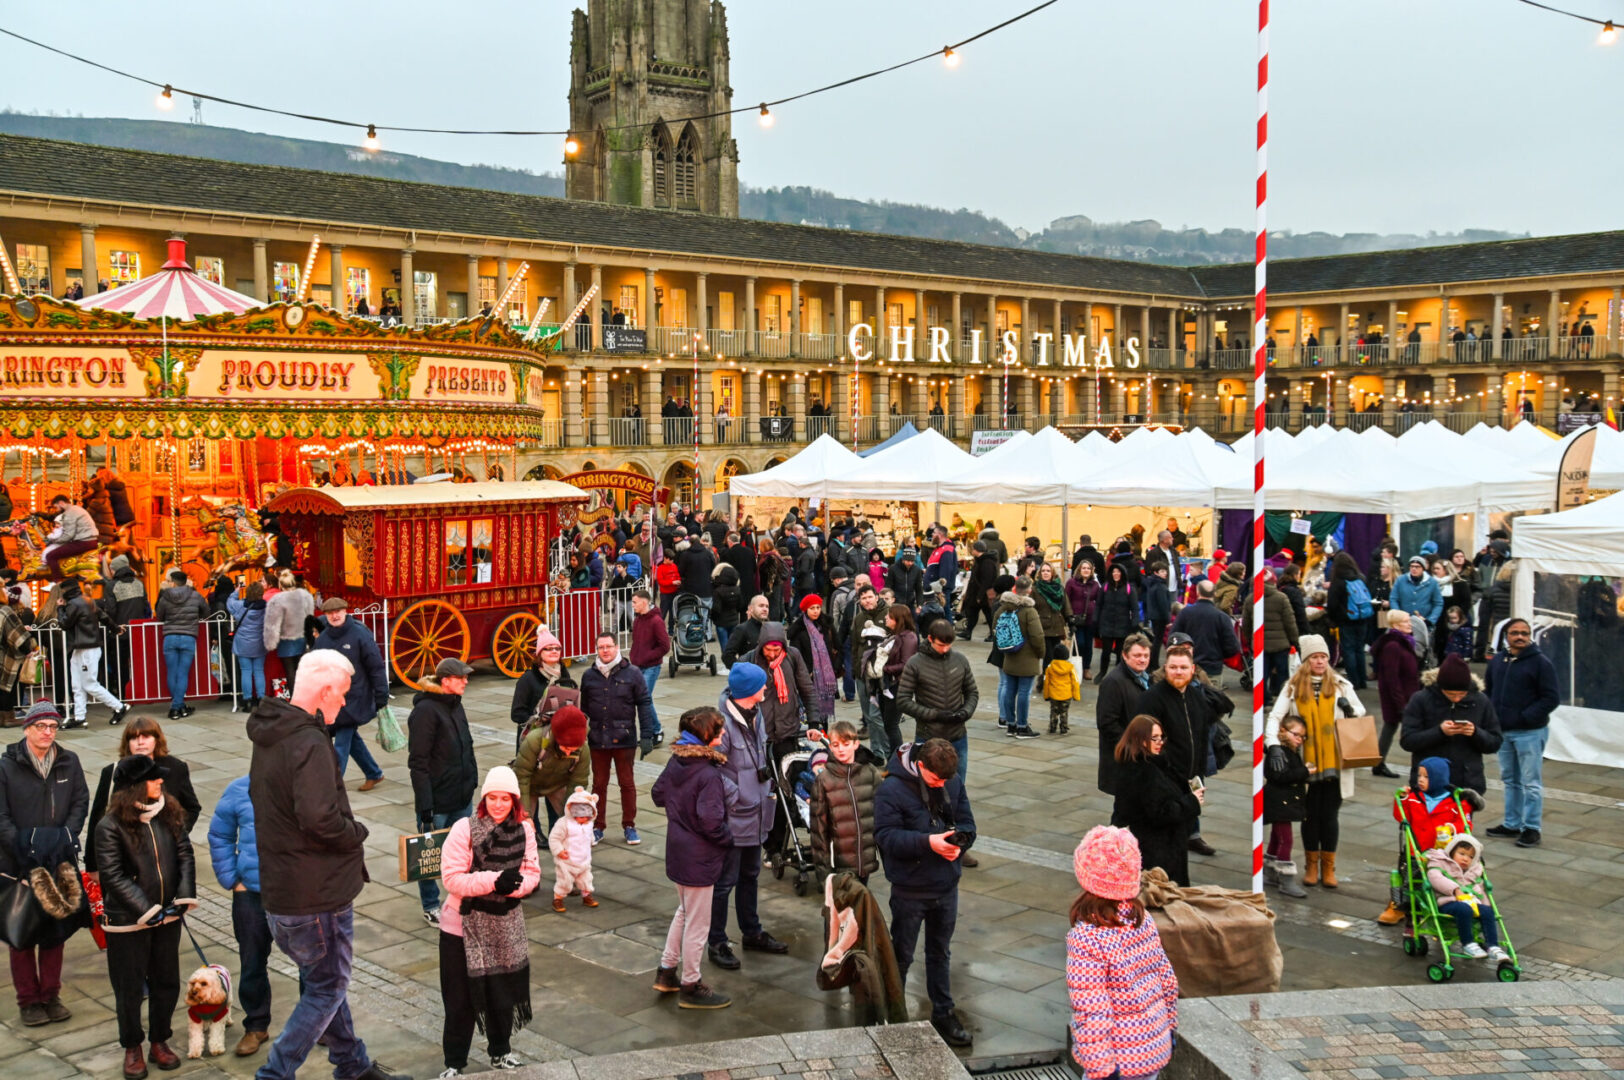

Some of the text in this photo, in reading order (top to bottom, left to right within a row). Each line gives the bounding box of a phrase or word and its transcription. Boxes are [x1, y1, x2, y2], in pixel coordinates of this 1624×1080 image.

[849, 323, 1142, 369] CHRISTMAS
[0, 356, 127, 389] RINGTON
[217, 359, 355, 395] PROUDLY
[424, 365, 507, 397] PRESENTS
[565, 473, 656, 493] ARRINGTONS
[420, 847, 441, 858] GOOD
[417, 855, 441, 867] THING
[420, 863, 441, 875] INSID
